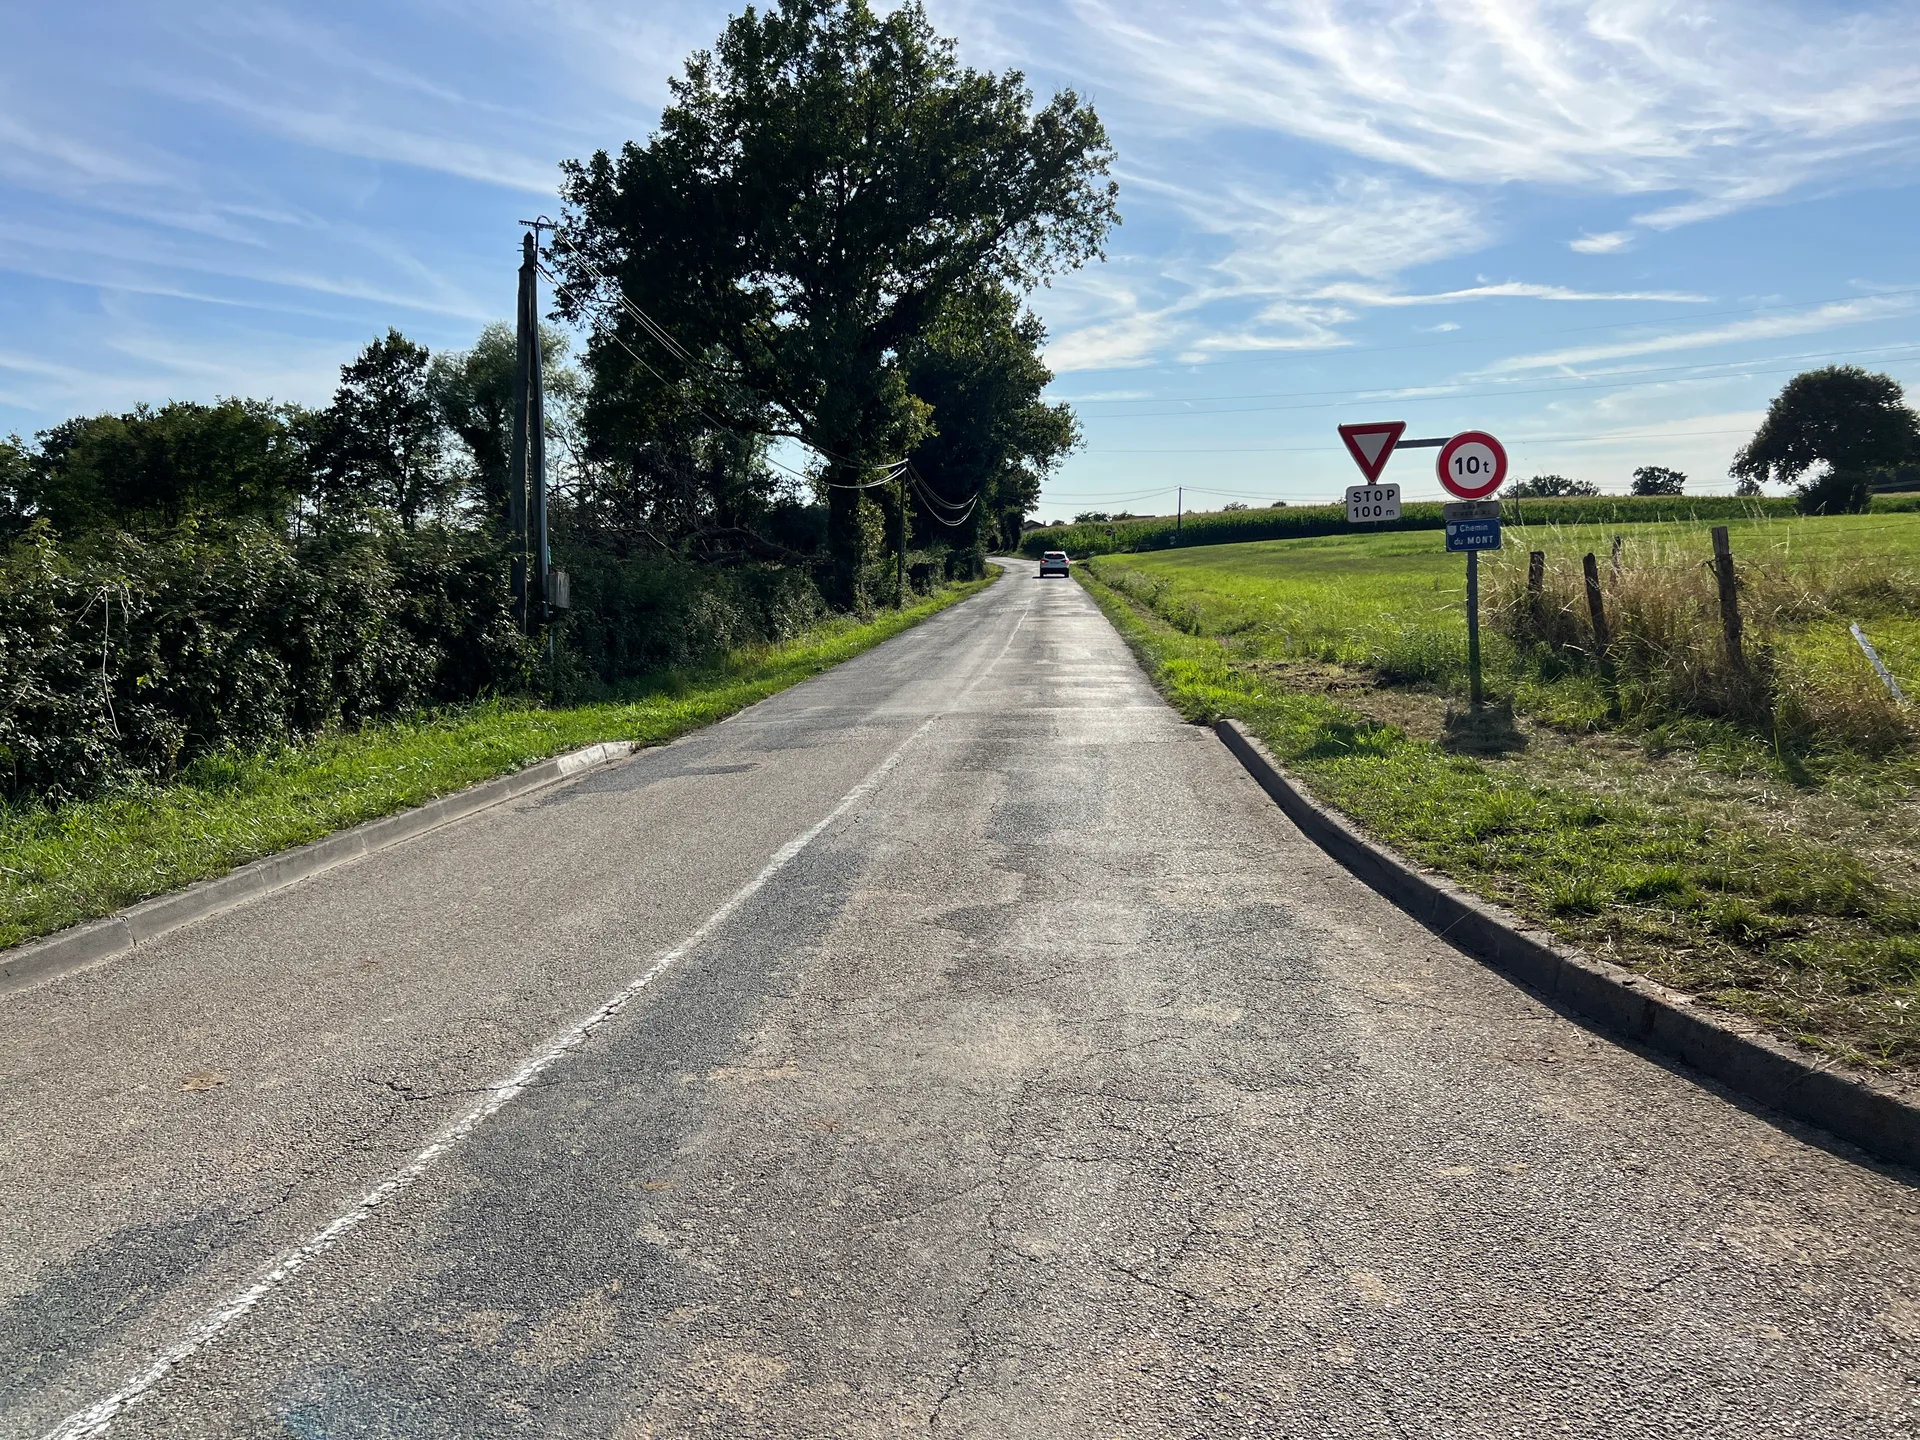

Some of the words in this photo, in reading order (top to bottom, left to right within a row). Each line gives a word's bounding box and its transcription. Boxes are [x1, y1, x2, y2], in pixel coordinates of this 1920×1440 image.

[1353, 489, 1395, 503] STOP
[1460, 524, 1489, 532] Chemin
[1454, 538, 1464, 546] du
[1467, 535, 1494, 545] MONT
